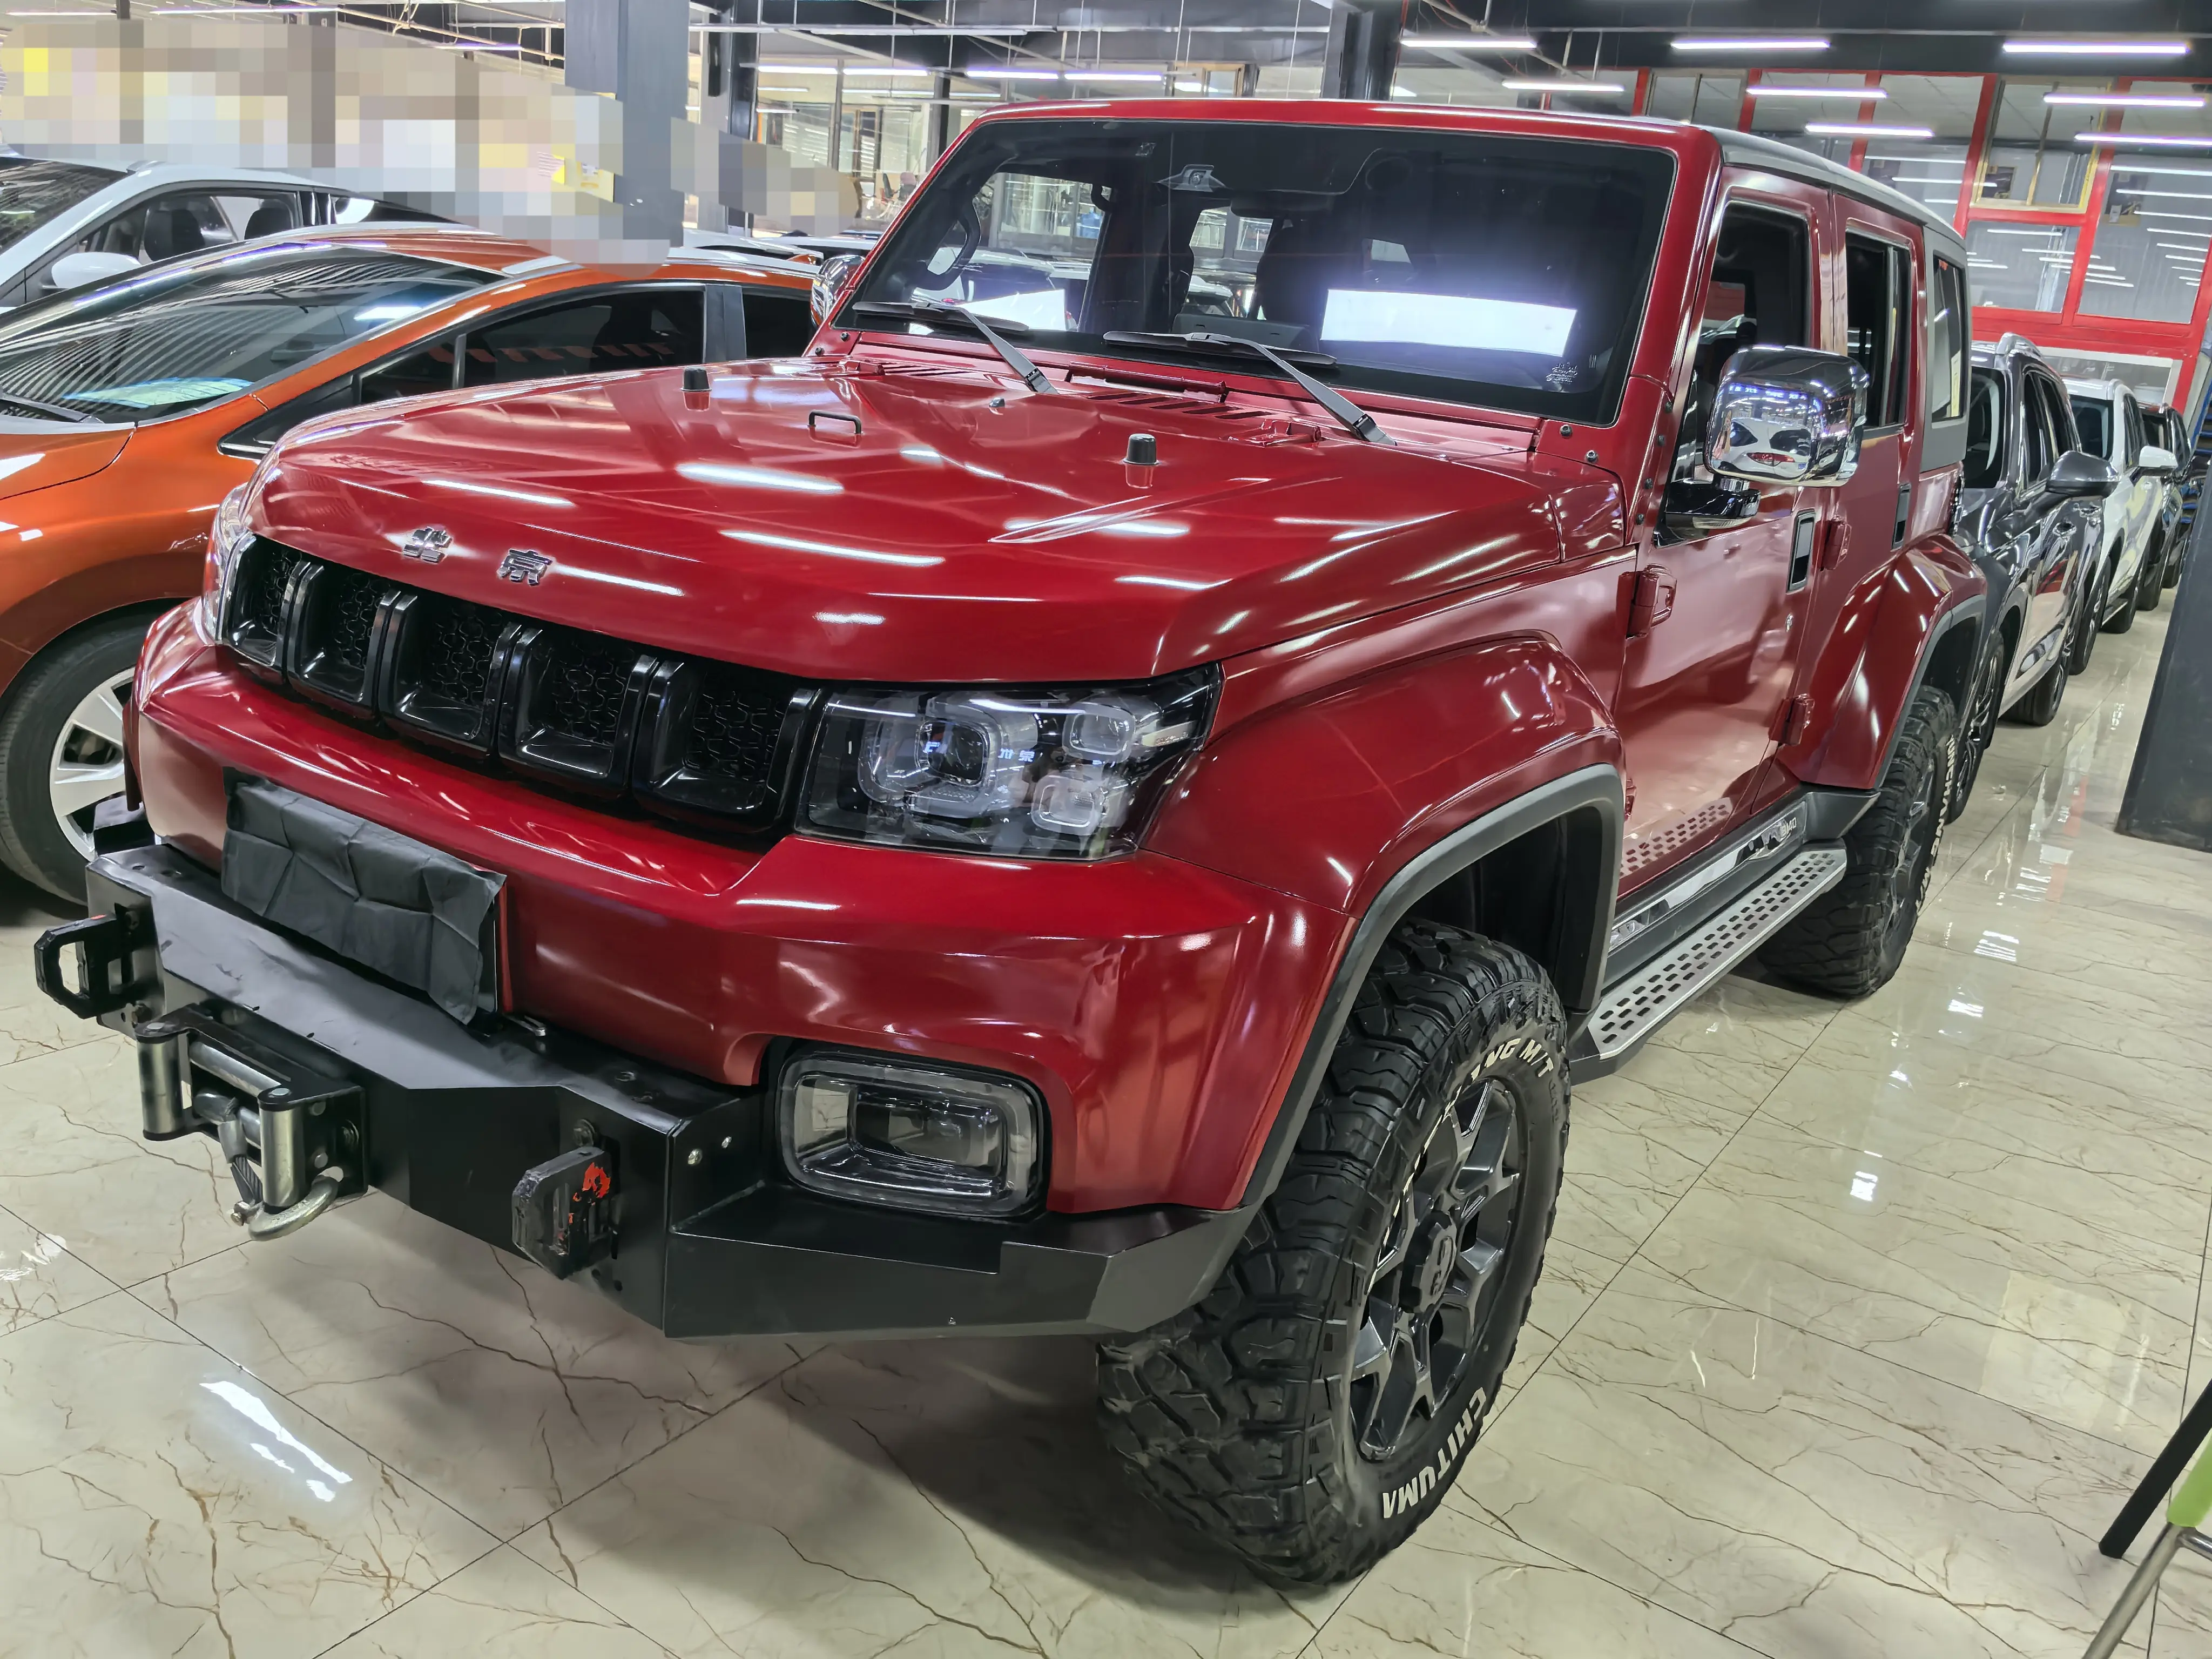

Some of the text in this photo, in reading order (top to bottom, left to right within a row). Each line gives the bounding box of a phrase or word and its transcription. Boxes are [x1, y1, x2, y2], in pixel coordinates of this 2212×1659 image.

[402, 526, 552, 585] 北京
[1519, 1039, 1554, 1077] M/T
[1382, 1387, 1486, 1518] CHITUMA
